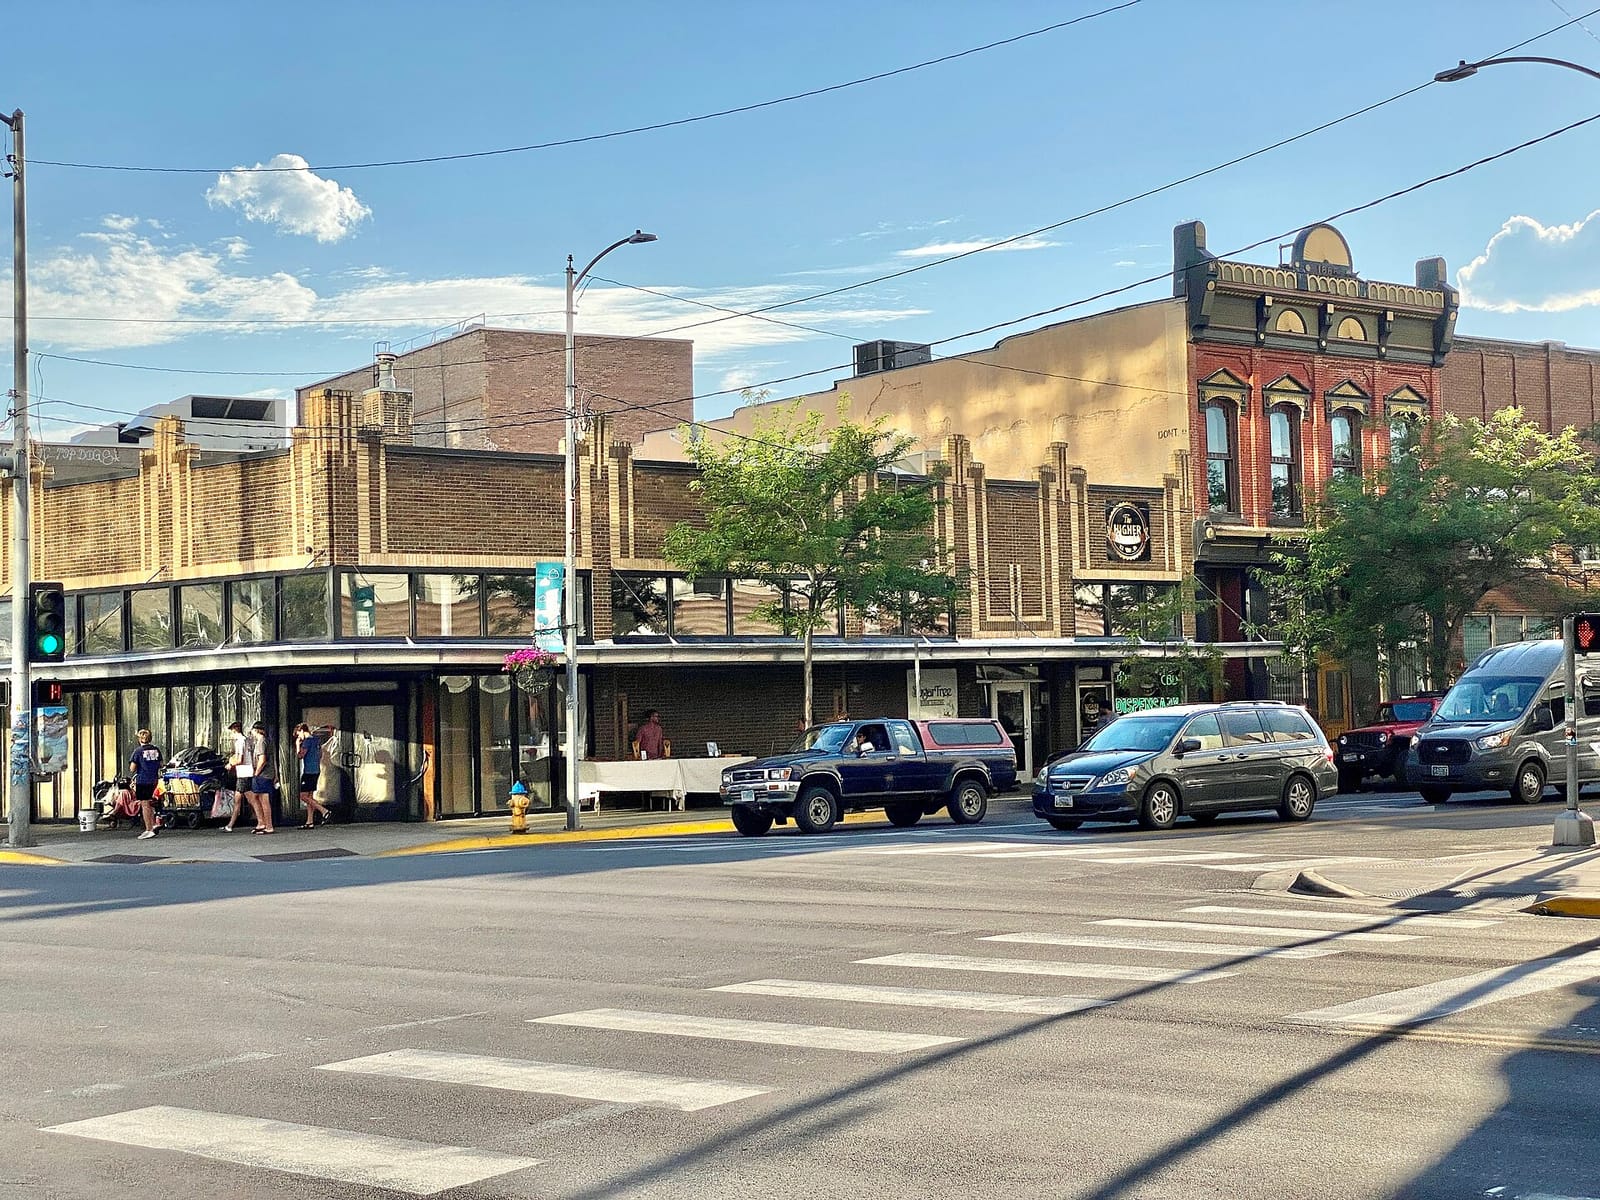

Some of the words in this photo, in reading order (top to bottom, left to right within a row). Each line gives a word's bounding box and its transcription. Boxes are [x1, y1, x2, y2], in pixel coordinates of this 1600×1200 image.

[1122, 513, 1133, 524] The
[1113, 523, 1142, 536] HIGHER
[911, 684, 953, 700] SgarTree
